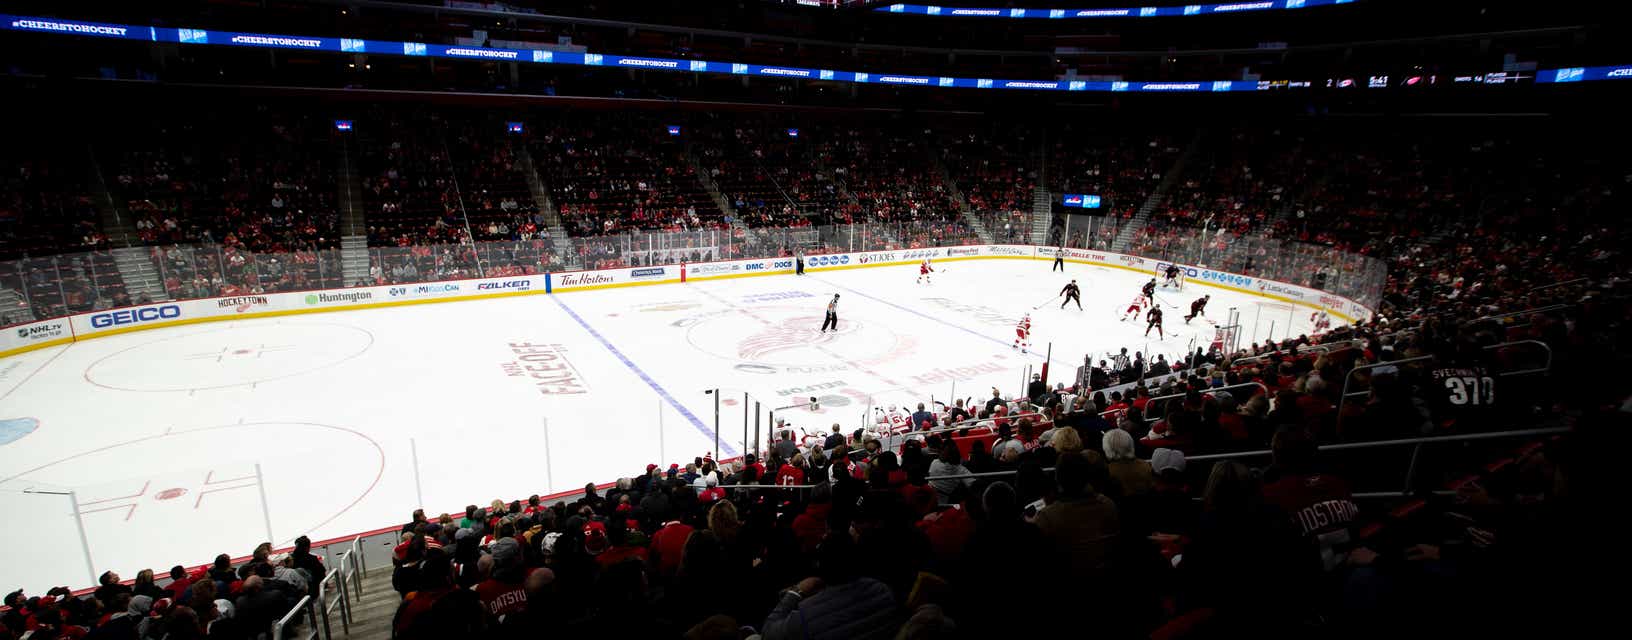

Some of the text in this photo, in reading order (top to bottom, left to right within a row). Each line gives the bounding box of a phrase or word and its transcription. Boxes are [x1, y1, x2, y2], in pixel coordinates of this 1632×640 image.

[12, 19, 127, 36] #CHEERSTOHOCKEY
[232, 35, 321, 48] #CHEERSTOHOCKEY
[446, 48, 518, 60] #CHEERSTOHOCKEY
[746, 263, 764, 271] DMC
[478, 280, 530, 290] FALKEN
[560, 273, 614, 286] Tim Hortons
[217, 295, 268, 308] HOCKEYTOWN
[319, 291, 372, 303] Huntington
[91, 305, 182, 329] GEICO
